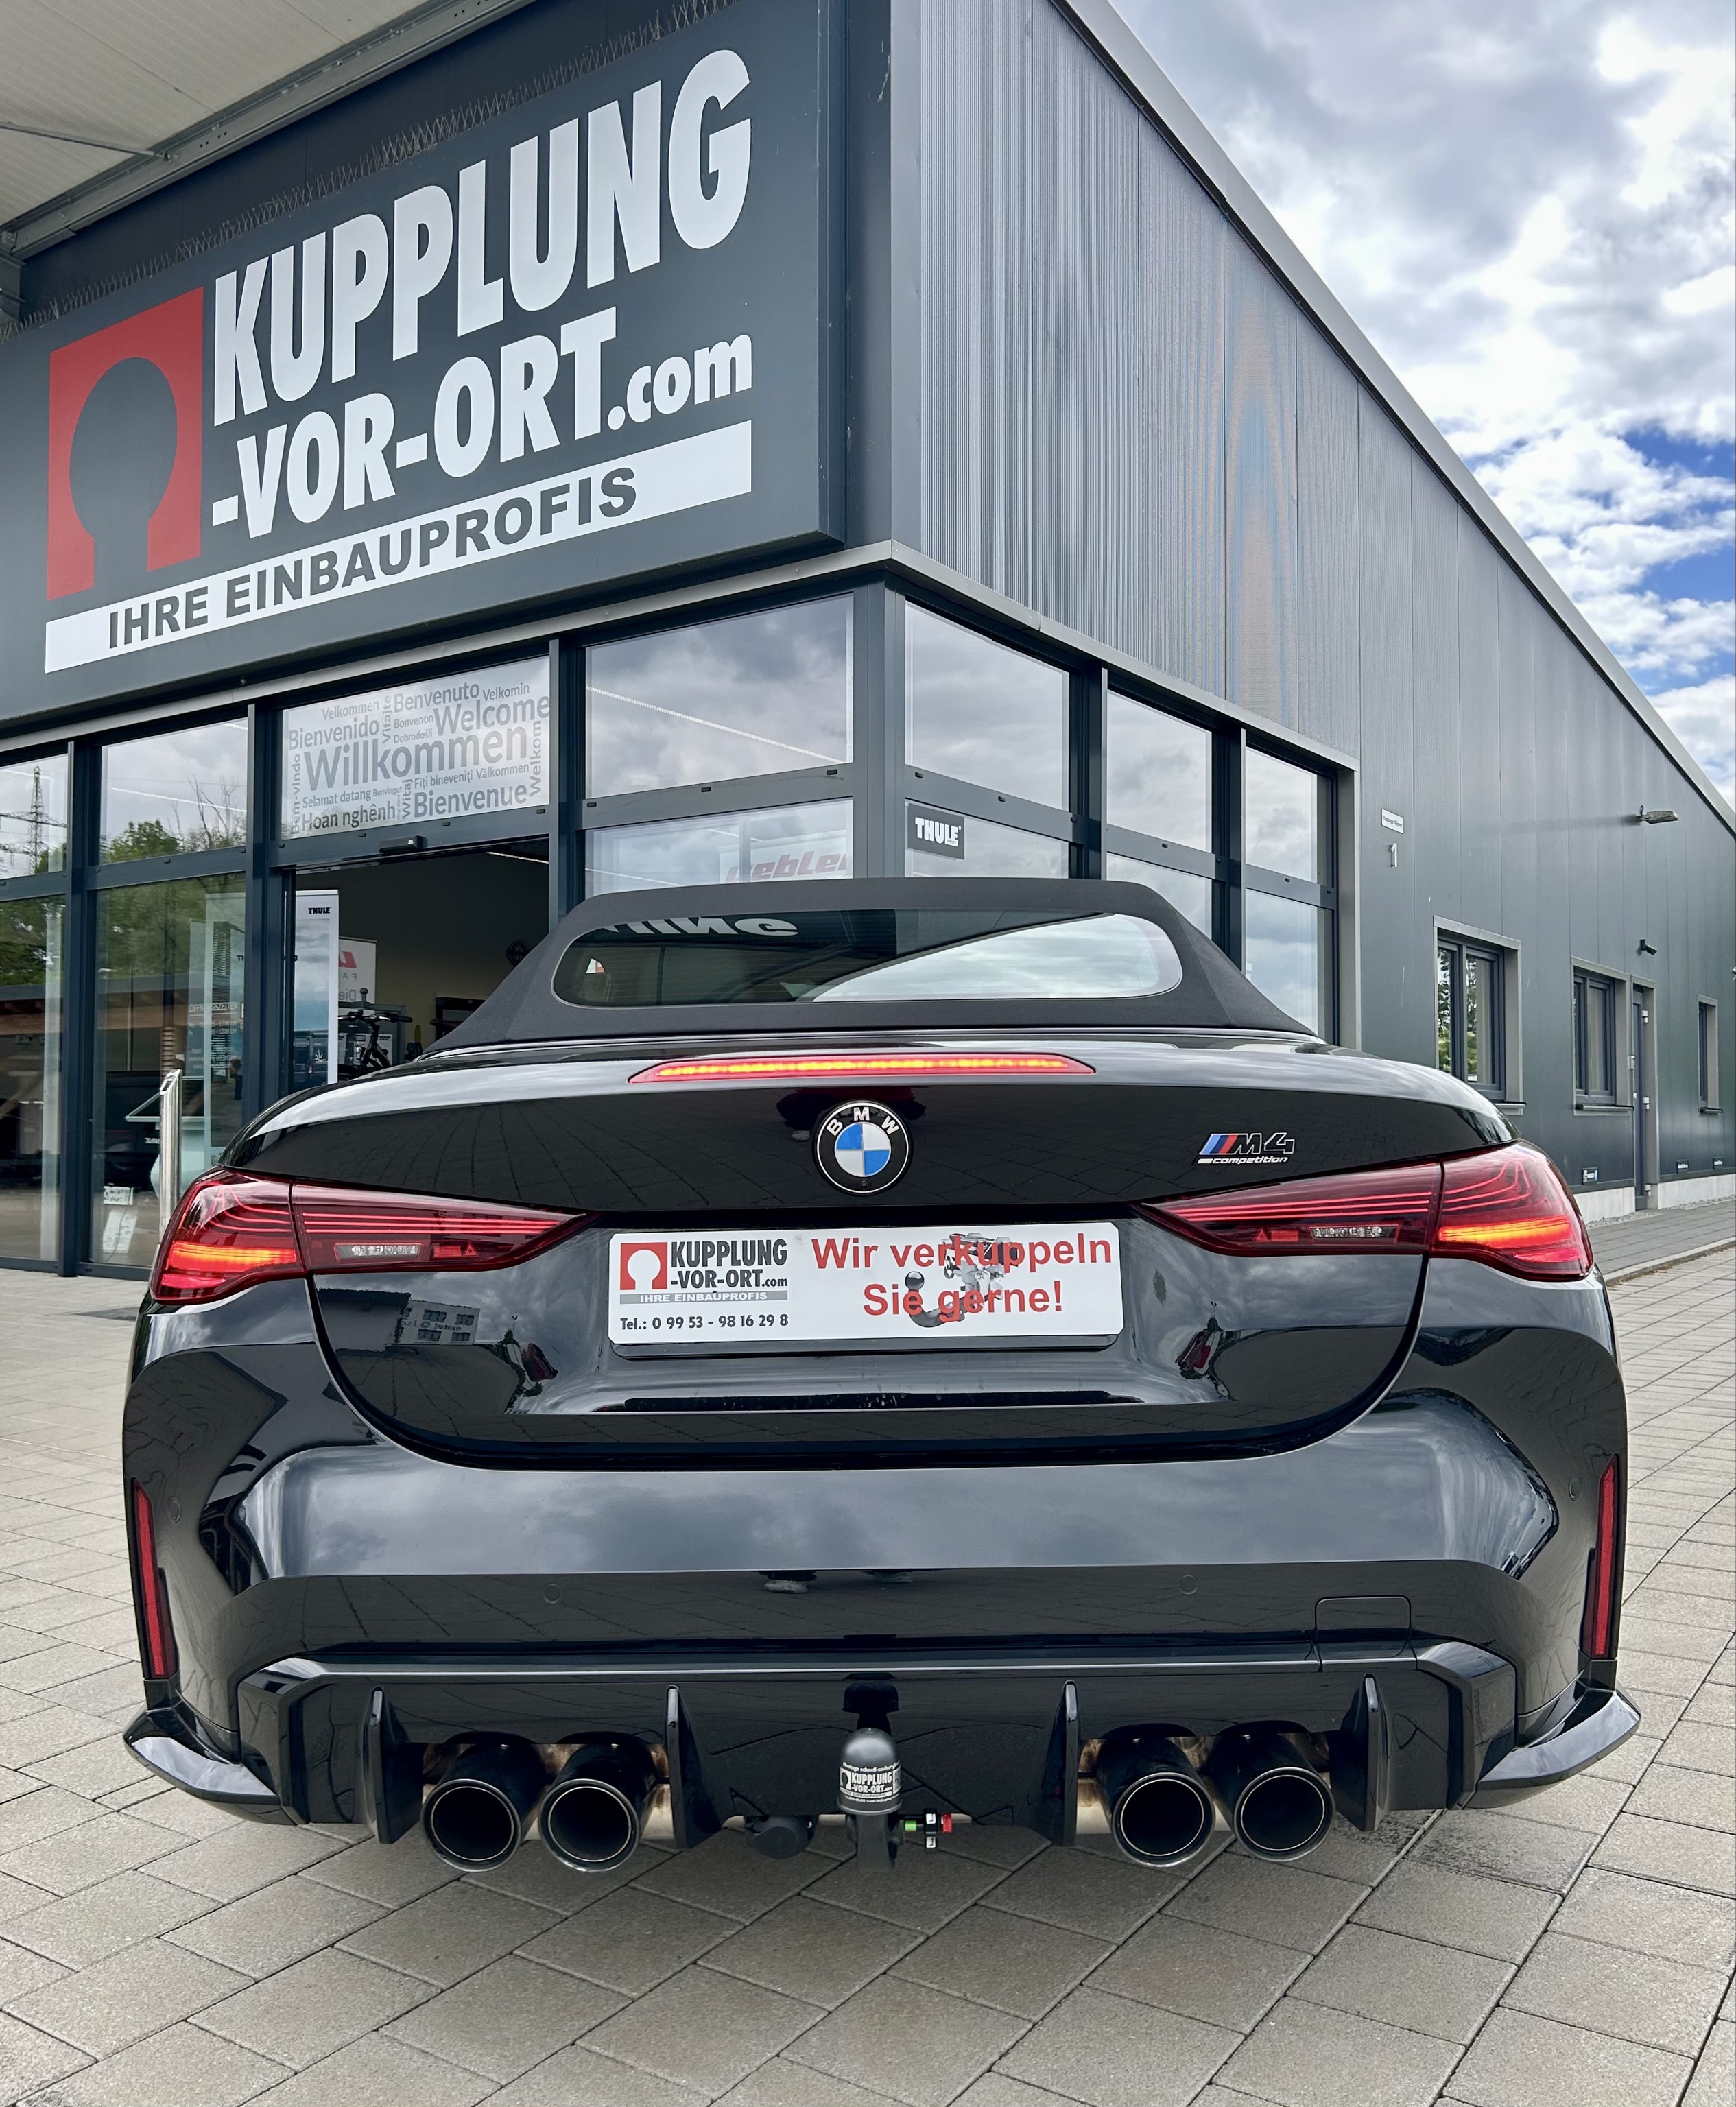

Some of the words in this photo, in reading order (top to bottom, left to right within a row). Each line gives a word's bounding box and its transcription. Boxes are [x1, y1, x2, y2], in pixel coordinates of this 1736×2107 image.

[213, 49, 752, 427] KUPPLUNG
[212, 307, 752, 539] -VOR-ORT.com
[109, 586, 209, 649] IHRE
[226, 467, 636, 618] EINBAUPROFIS
[394, 682, 480, 713] Benvenuto
[482, 682, 530, 701] Velkomin
[322, 701, 379, 720] Velkommen
[383, 695, 393, 744] Vitajte
[394, 715, 433, 729] Bonvenon
[433, 695, 549, 736] Welcome
[289, 715, 379, 750] Bienvenido
[394, 728, 432, 743] Dobrodošli
[304, 726, 526, 791] Willkommen
[530, 721, 541, 796] Welkom
[292, 753, 300, 835] Bem-vindo
[302, 793, 338, 809] Selamat
[340, 789, 371, 803] datang
[372, 786, 402, 796] Benvingut
[402, 778, 413, 819] Witaj
[414, 784, 527, 818] Bienvenue
[302, 812, 338, 831] Hoan
[343, 801, 395, 828] nghênh
[915, 817, 959, 847] THULE
[1391, 842, 1397, 867] 1
[826, 1106, 899, 1136] BMW
[1199, 1133, 1295, 1155] M4
[1212, 1155, 1288, 1165] competition
[671, 1239, 787, 1267] KUPPLUNG
[811, 1237, 878, 1270] Wir
[890, 1233, 1111, 1274] verkuppeln
[671, 1269, 787, 1289] -VOR-ORT.com
[640, 1294, 671, 1302] IHRE
[674, 1291, 768, 1302] EINBAUPROFIS
[863, 1283, 923, 1316] Sie
[938, 1281, 1062, 1322] gerne!
[620, 1317, 647, 1330] Tel.:
[652, 1317, 661, 1329] 0
[667, 1316, 684, 1329] 99
[689, 1316, 703, 1329] 53
[718, 1315, 736, 1327] 98
[741, 1315, 754, 1327] 16
[759, 1314, 775, 1326] 29
[779, 1313, 789, 1326] 8
[851, 1771, 892, 1785] KUPPLUNG
